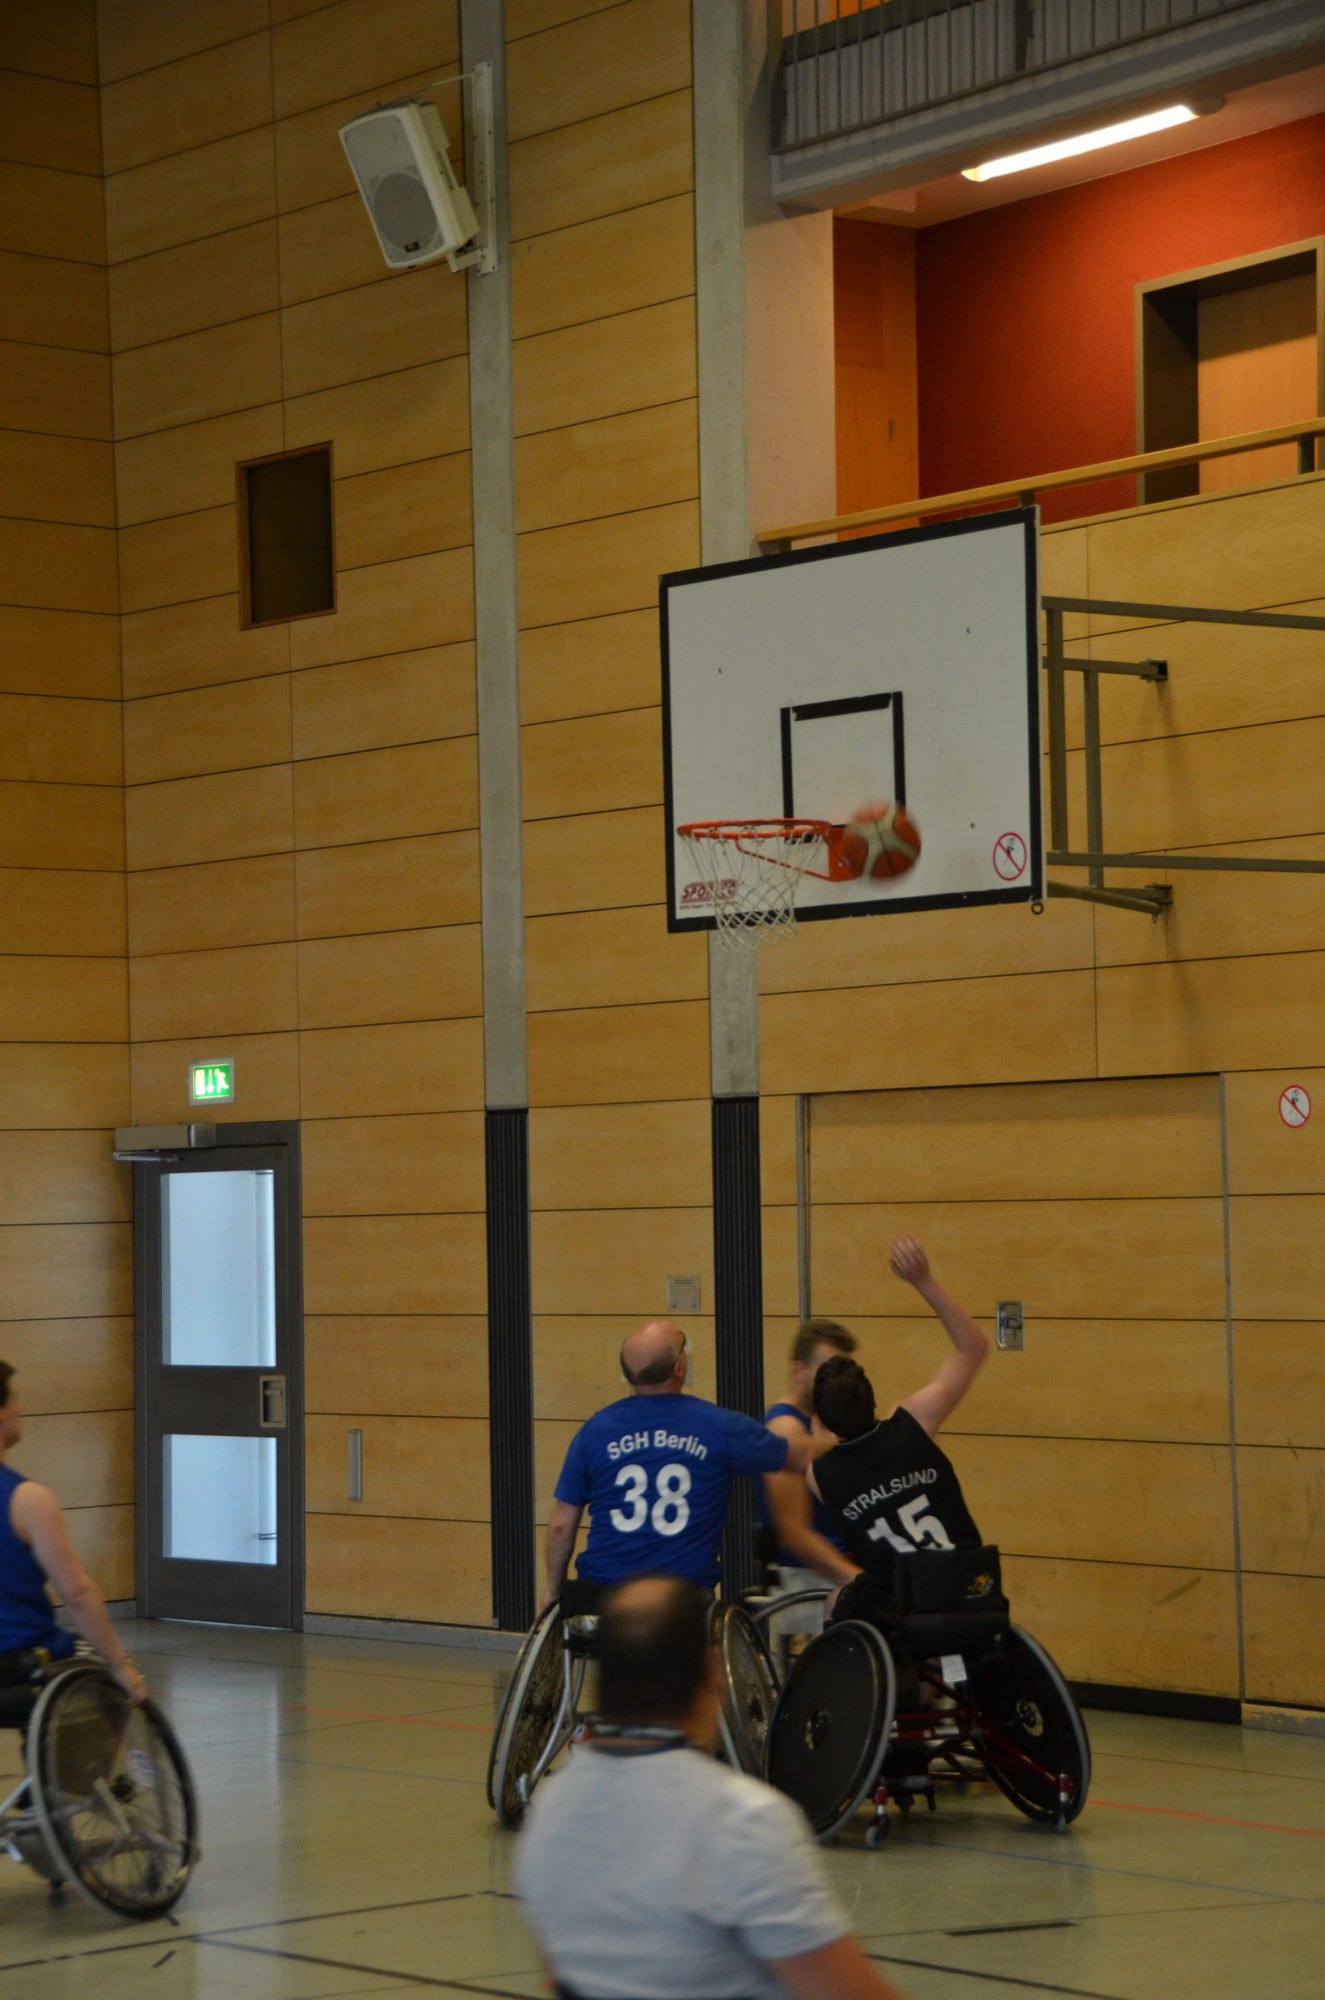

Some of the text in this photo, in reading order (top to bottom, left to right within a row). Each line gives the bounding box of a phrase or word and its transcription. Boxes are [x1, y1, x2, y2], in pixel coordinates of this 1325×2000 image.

[607, 1429, 708, 1460] SGH Berlin
[609, 1463, 692, 1536] 38
[842, 1468, 937, 1520] STRALSUND
[866, 1493, 956, 1553] 15
